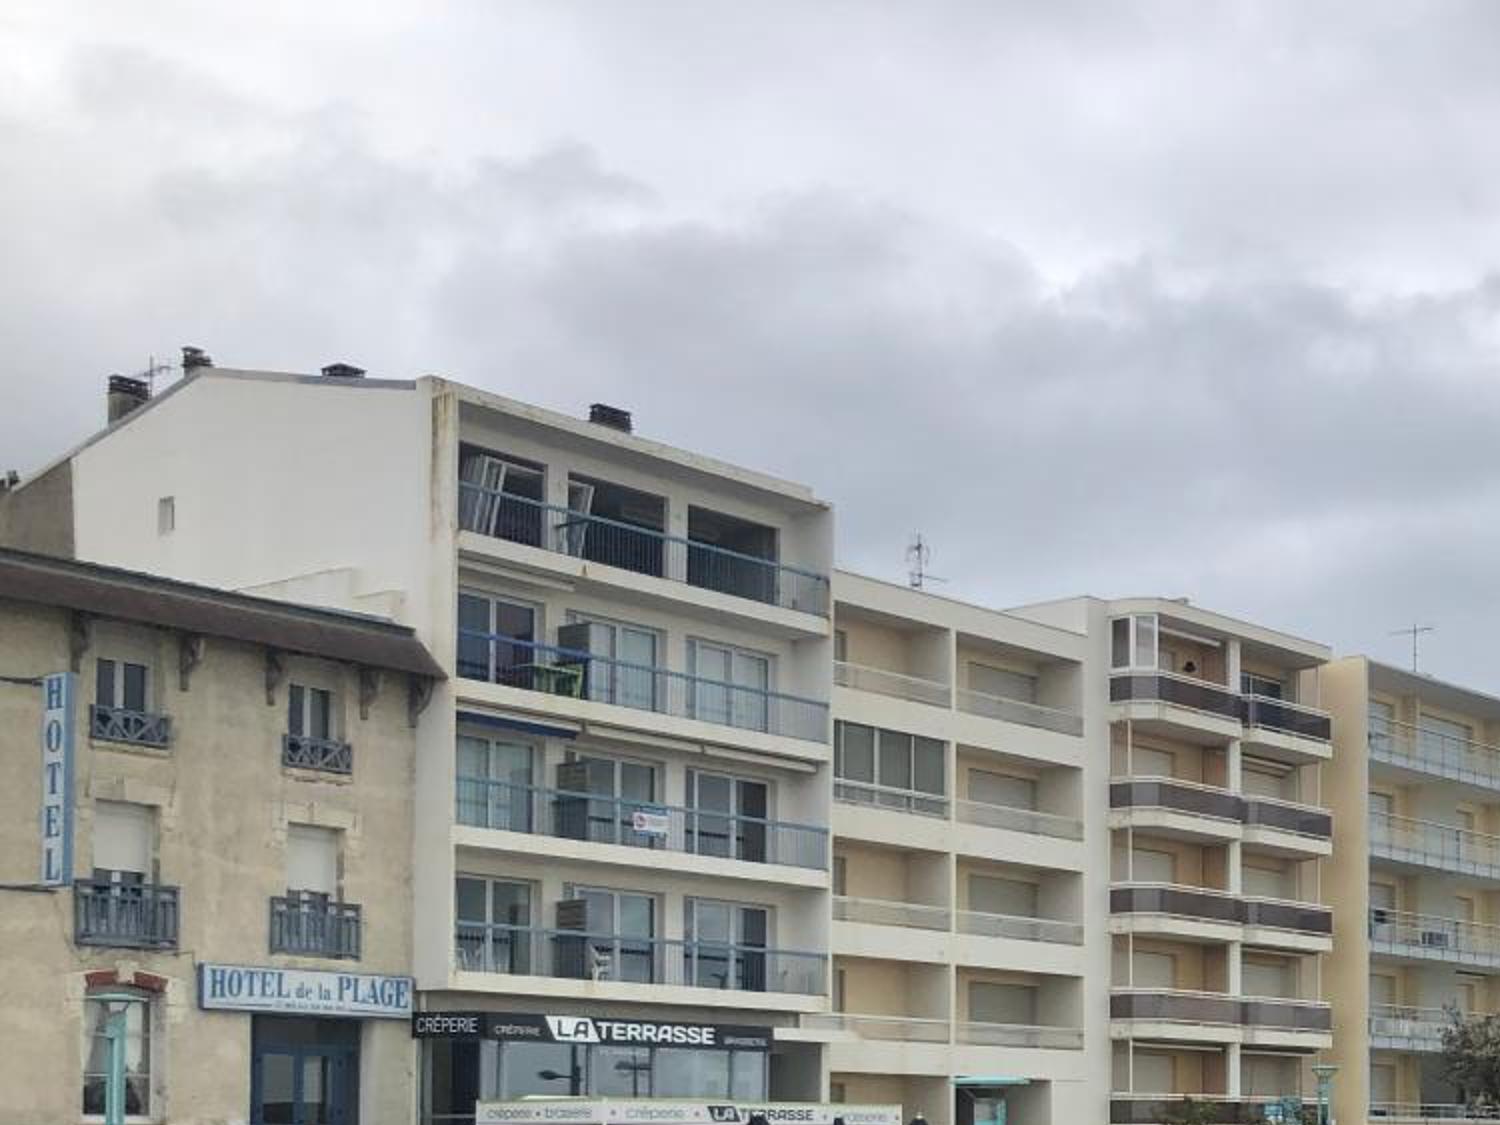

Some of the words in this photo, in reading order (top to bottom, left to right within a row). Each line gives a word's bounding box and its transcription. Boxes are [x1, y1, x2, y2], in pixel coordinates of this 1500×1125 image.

[46, 678, 63, 880] HOTEL
[211, 969, 291, 998] HOTEL
[295, 983, 312, 1000] de
[319, 984, 331, 1001] la
[338, 976, 409, 1009] PLAGE
[556, 1018, 591, 1039] LA
[597, 1021, 715, 1045] TERRASSE
[712, 1107, 735, 1121] LA
[740, 1108, 814, 1121] TRASSE
